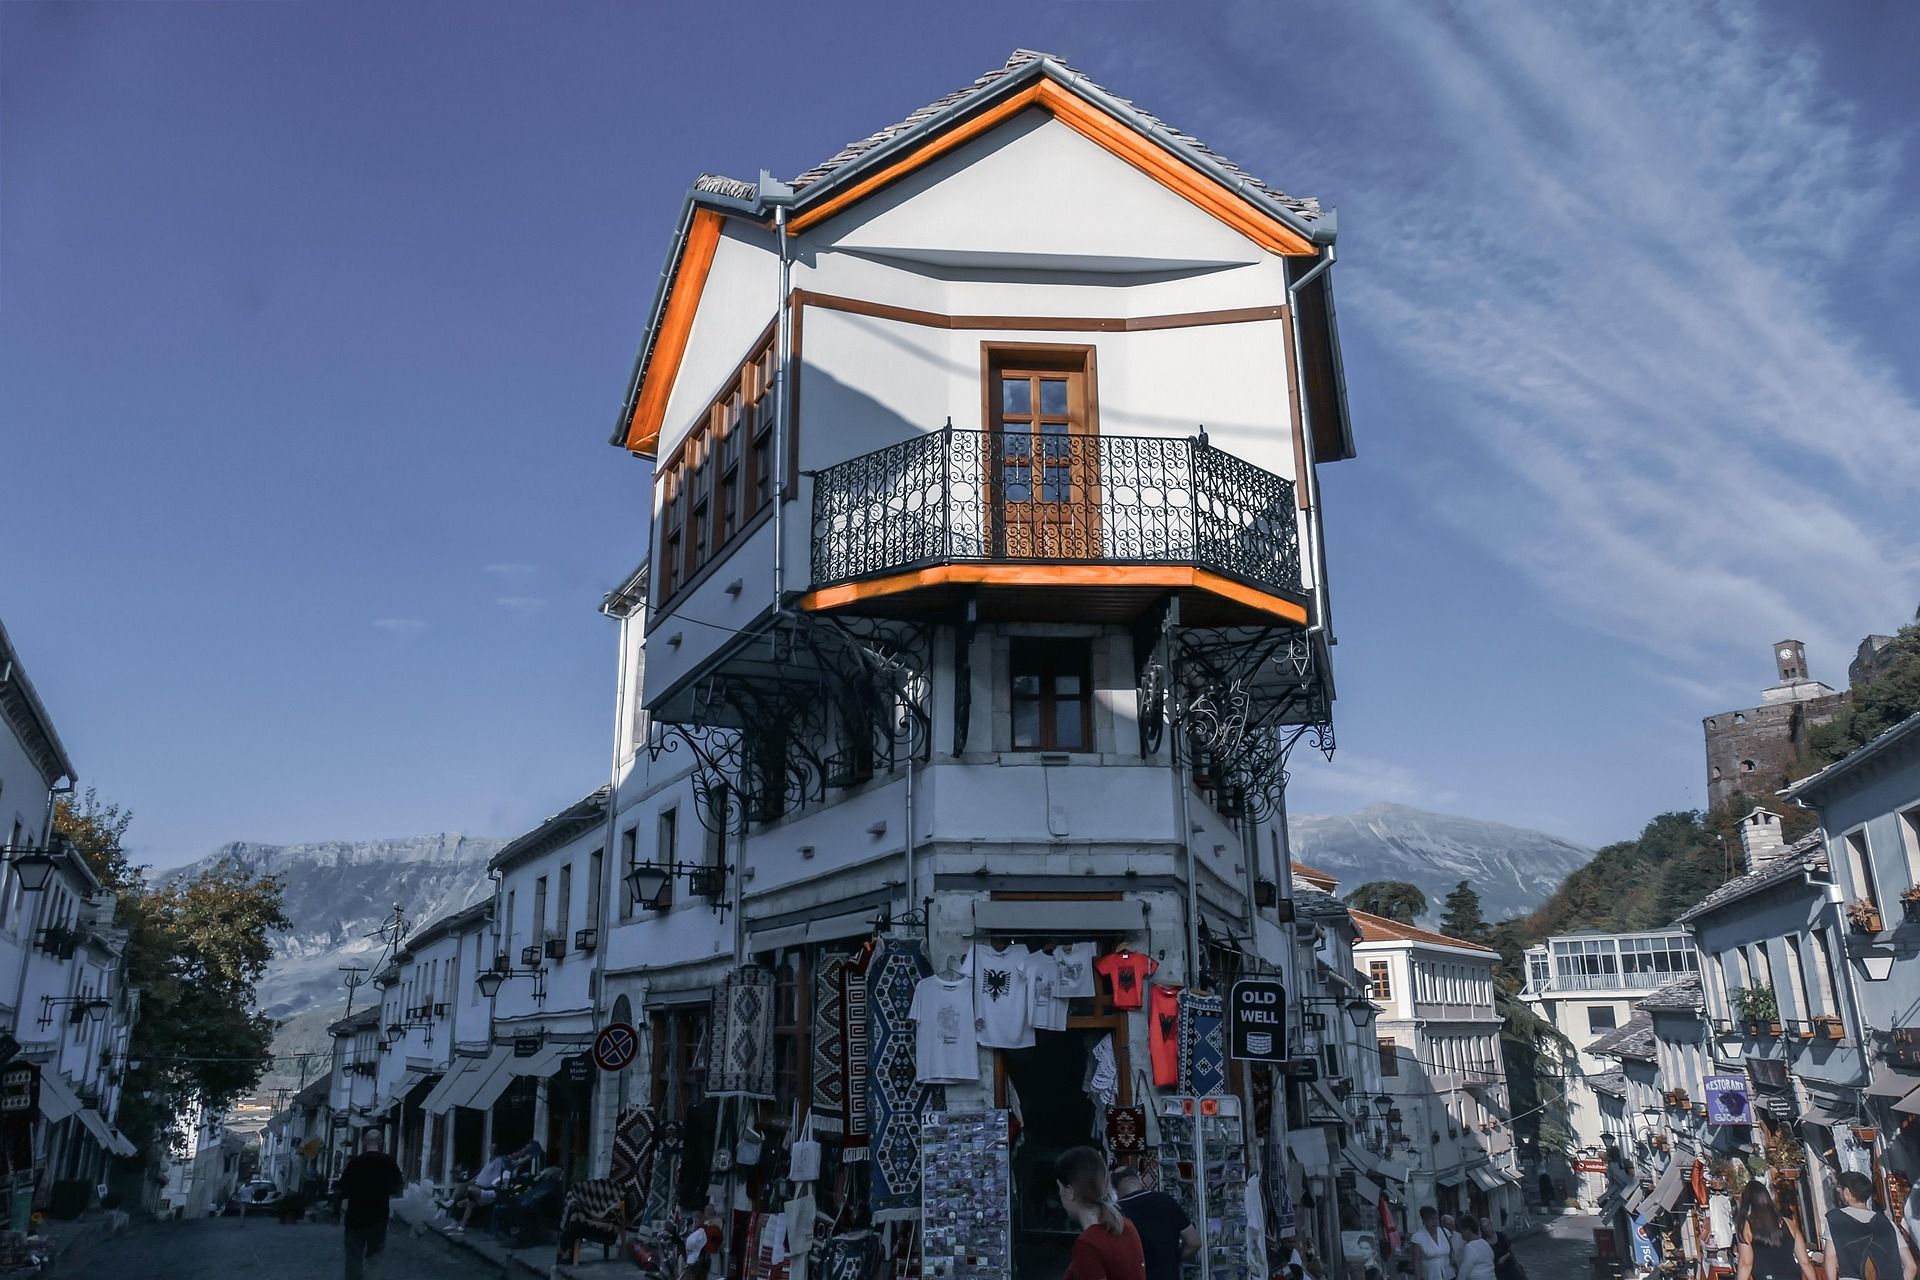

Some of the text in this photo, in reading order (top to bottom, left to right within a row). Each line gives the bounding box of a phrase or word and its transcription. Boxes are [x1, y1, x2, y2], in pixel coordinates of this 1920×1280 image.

[1241, 992, 1276, 1005] OLD
[1240, 1010, 1279, 1024] WELL
[1705, 1078, 1744, 1091] RESTORANT
[921, 1112, 936, 1125] 1€
